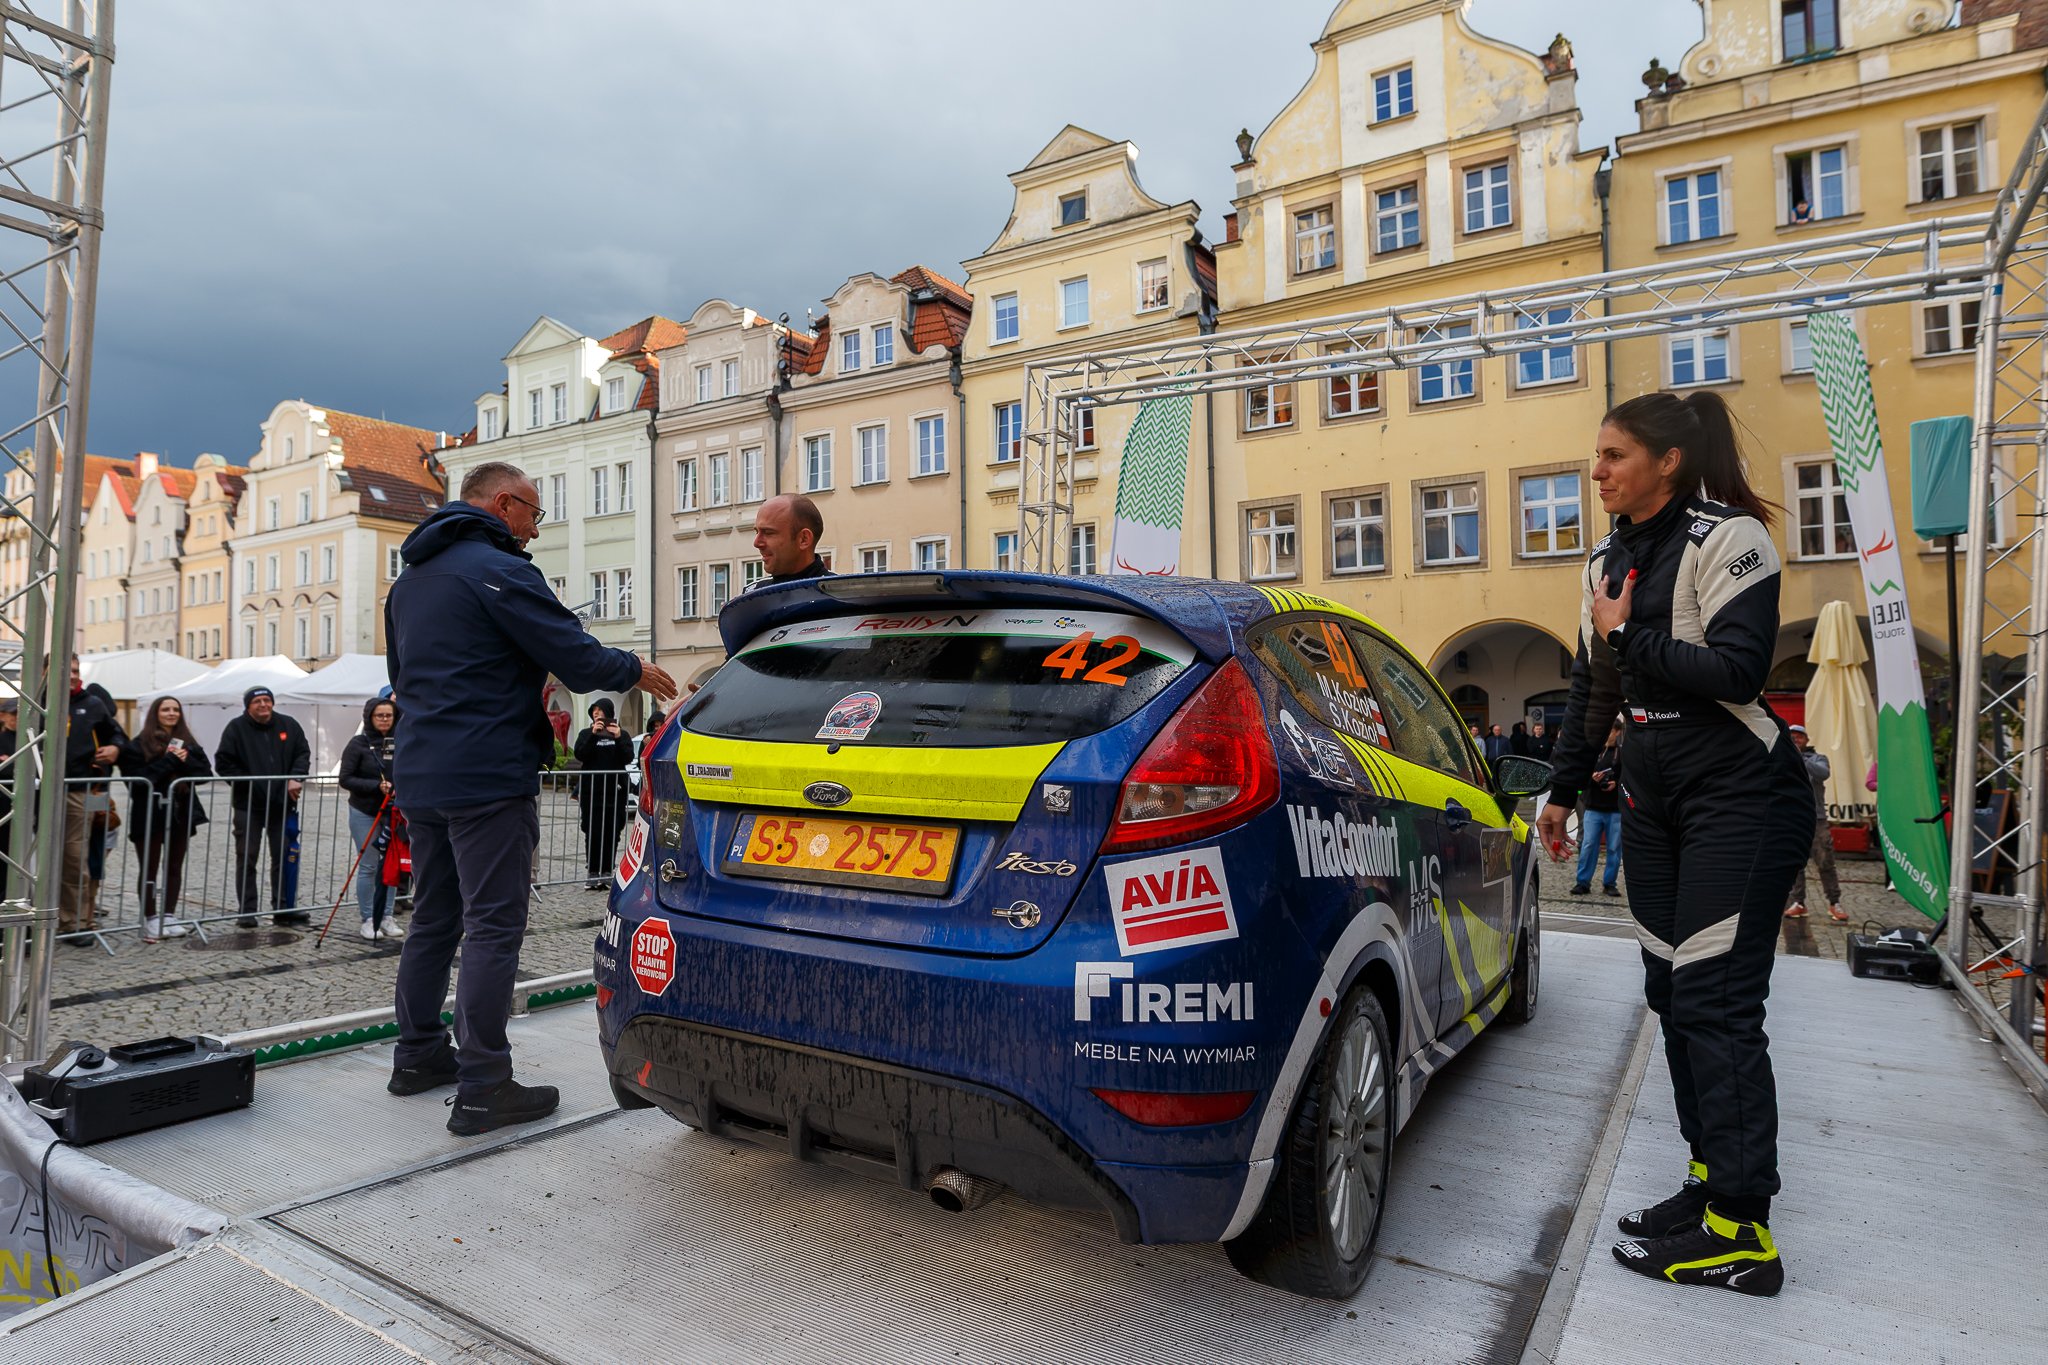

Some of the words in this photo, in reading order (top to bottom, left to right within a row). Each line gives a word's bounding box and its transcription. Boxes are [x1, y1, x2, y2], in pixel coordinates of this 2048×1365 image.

[1729, 551, 1760, 577] OMP
[1041, 631, 1141, 687] 42
[1320, 618, 1368, 688] 42
[812, 786, 839, 802] Ford
[731, 844, 744, 857] PL
[752, 819, 805, 864] S5
[834, 824, 944, 877] 2575
[1286, 804, 1401, 878] VitaComfort
[995, 852, 1077, 877] Fiesta
[637, 932, 669, 957] STOP
[636, 966, 667, 981] KIEROWCOM
[637, 954, 667, 971] PIJANYM
[1074, 961, 1255, 1023] FIREMI
[1075, 1041, 1141, 1063] MEBLE
[1148, 1047, 1176, 1064] NA
[1182, 1046, 1256, 1064] WYMIAR
[1703, 1264, 1735, 1277] FIRST
